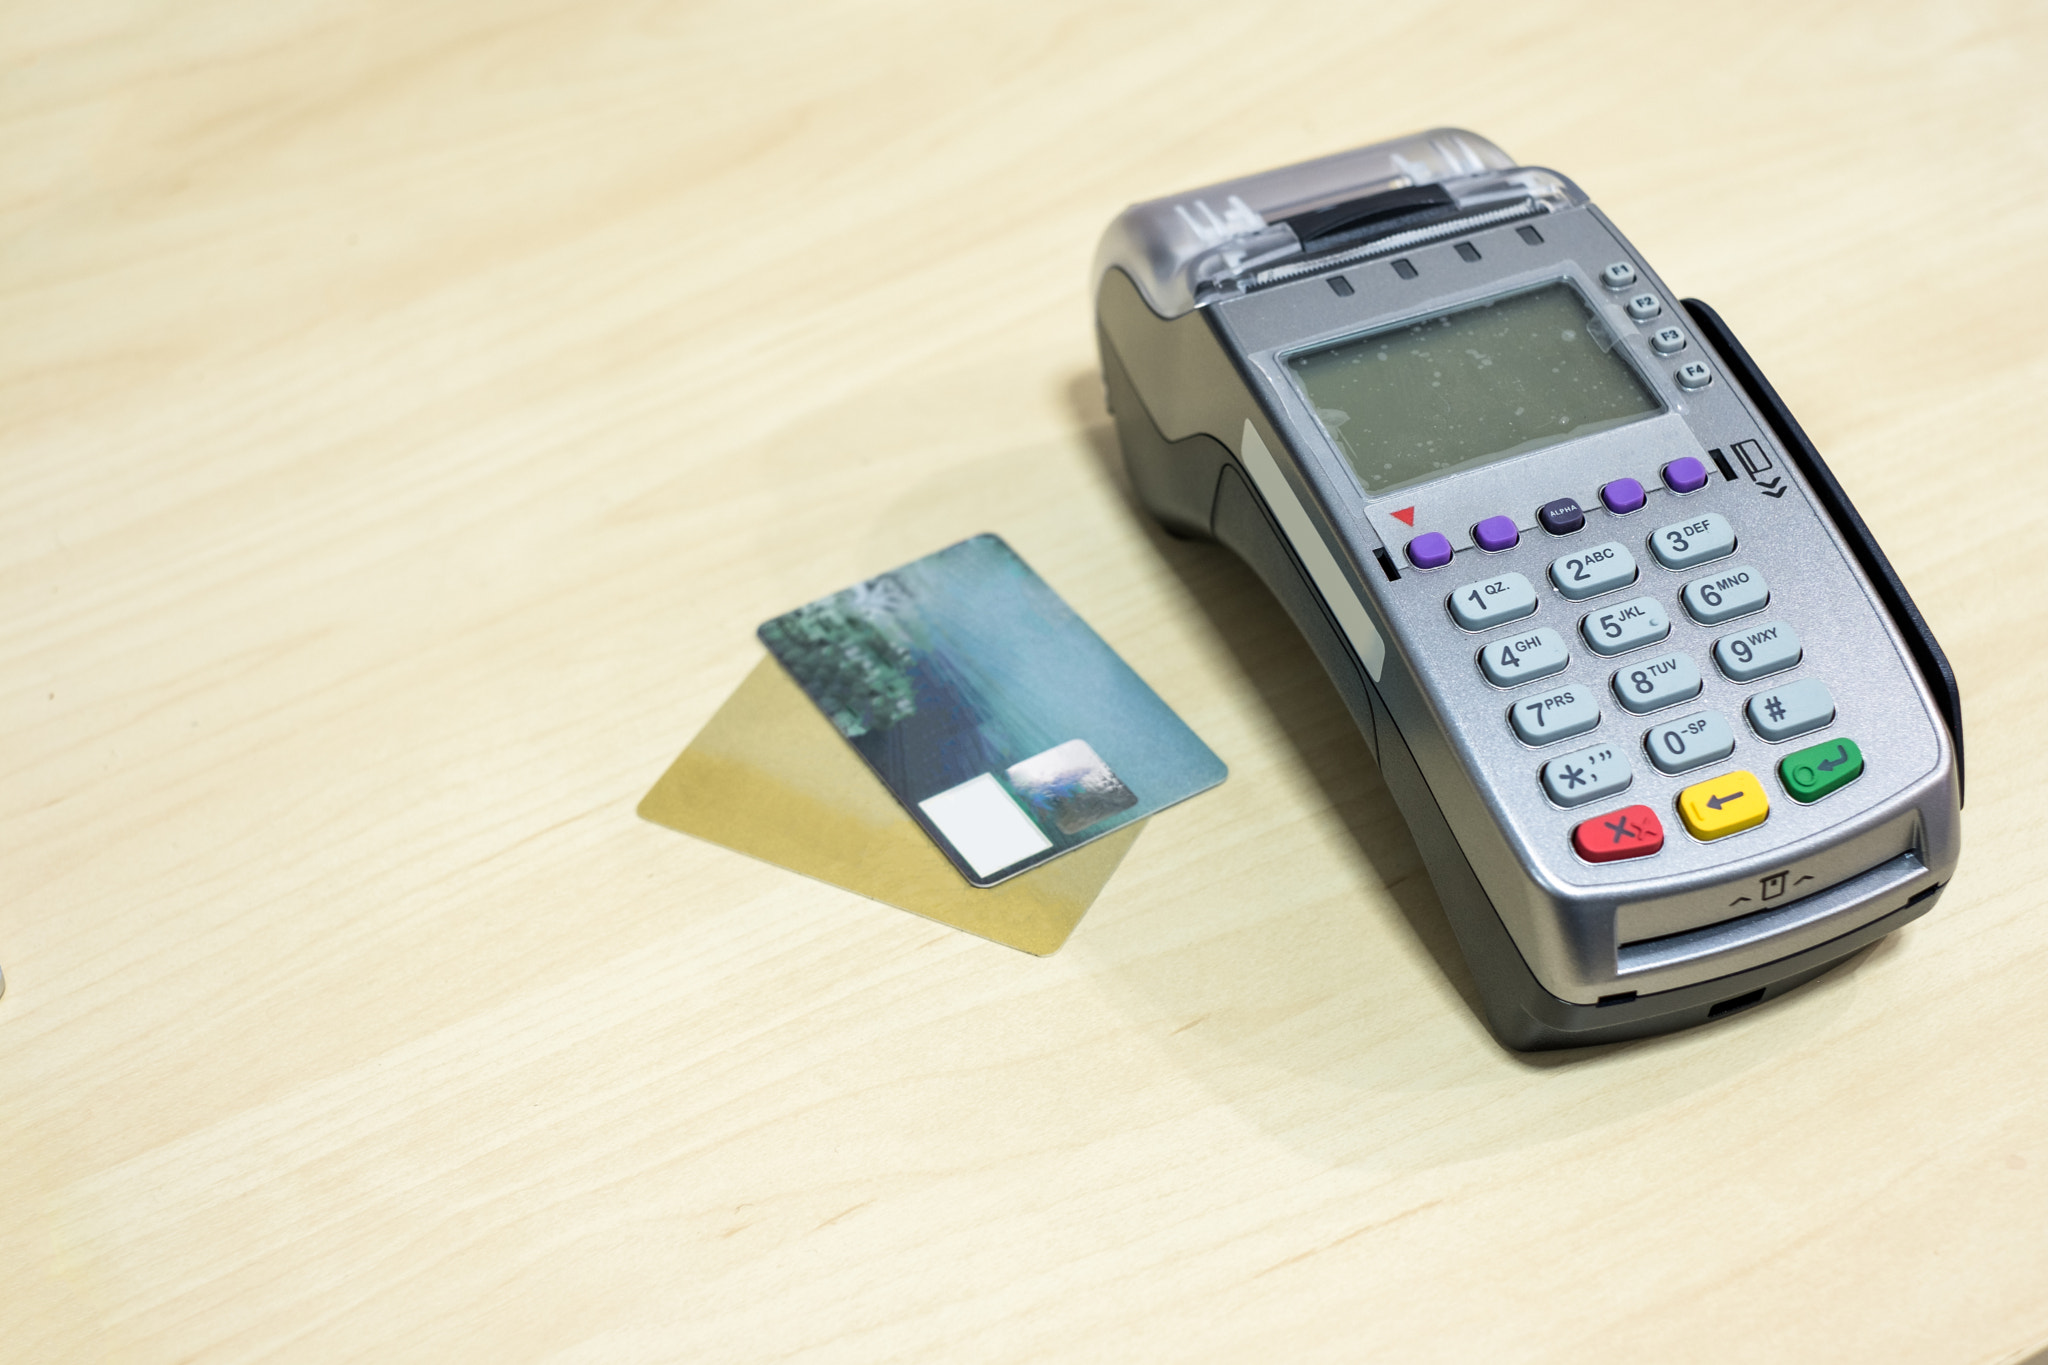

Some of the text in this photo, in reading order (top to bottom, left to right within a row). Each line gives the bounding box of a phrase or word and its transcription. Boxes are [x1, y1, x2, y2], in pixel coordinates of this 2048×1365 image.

[1612, 264, 1629, 275] F1
[1636, 296, 1655, 308] F2
[1661, 330, 1679, 341] F3
[1686, 364, 1705, 377] F4
[1550, 504, 1577, 517] ALPHA
[1666, 519, 1711, 552] 3 DEF
[1566, 548, 1614, 581] 2 ABC
[1700, 572, 1749, 607] 6 MNO
[1600, 605, 1645, 638] 5 JKL
[1500, 636, 1541, 667] 4 GHI
[1730, 627, 1778, 663] 9 WXY
[1631, 659, 1677, 694] 8 TUV
[1526, 692, 1575, 727] 7 PRS
[1764, 696, 1786, 722] #
